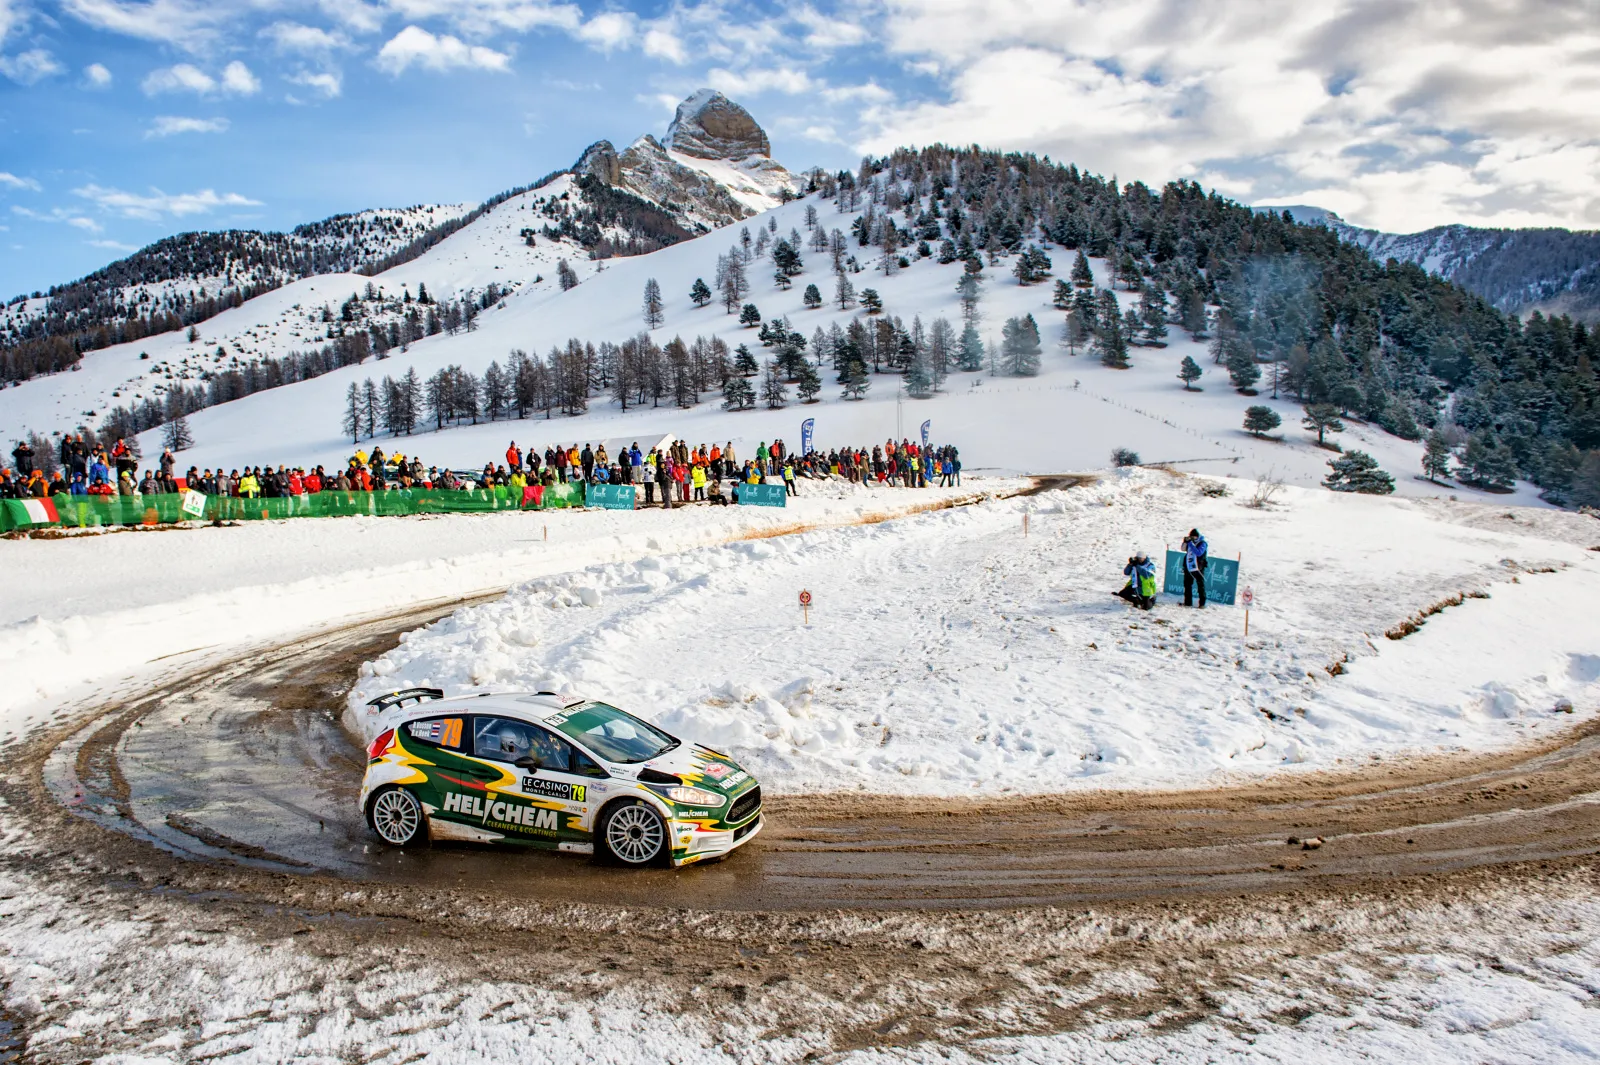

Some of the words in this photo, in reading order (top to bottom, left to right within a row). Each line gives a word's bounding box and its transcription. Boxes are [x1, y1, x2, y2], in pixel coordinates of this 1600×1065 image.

[442, 719, 463, 748] 79
[523, 778, 533, 786] LE
[534, 779, 569, 793] CASINO
[526, 787, 567, 798] MONTE-CARLO
[572, 784, 585, 802] 79
[487, 820, 517, 832] CLEANERS
[524, 827, 557, 838] COATINGS
